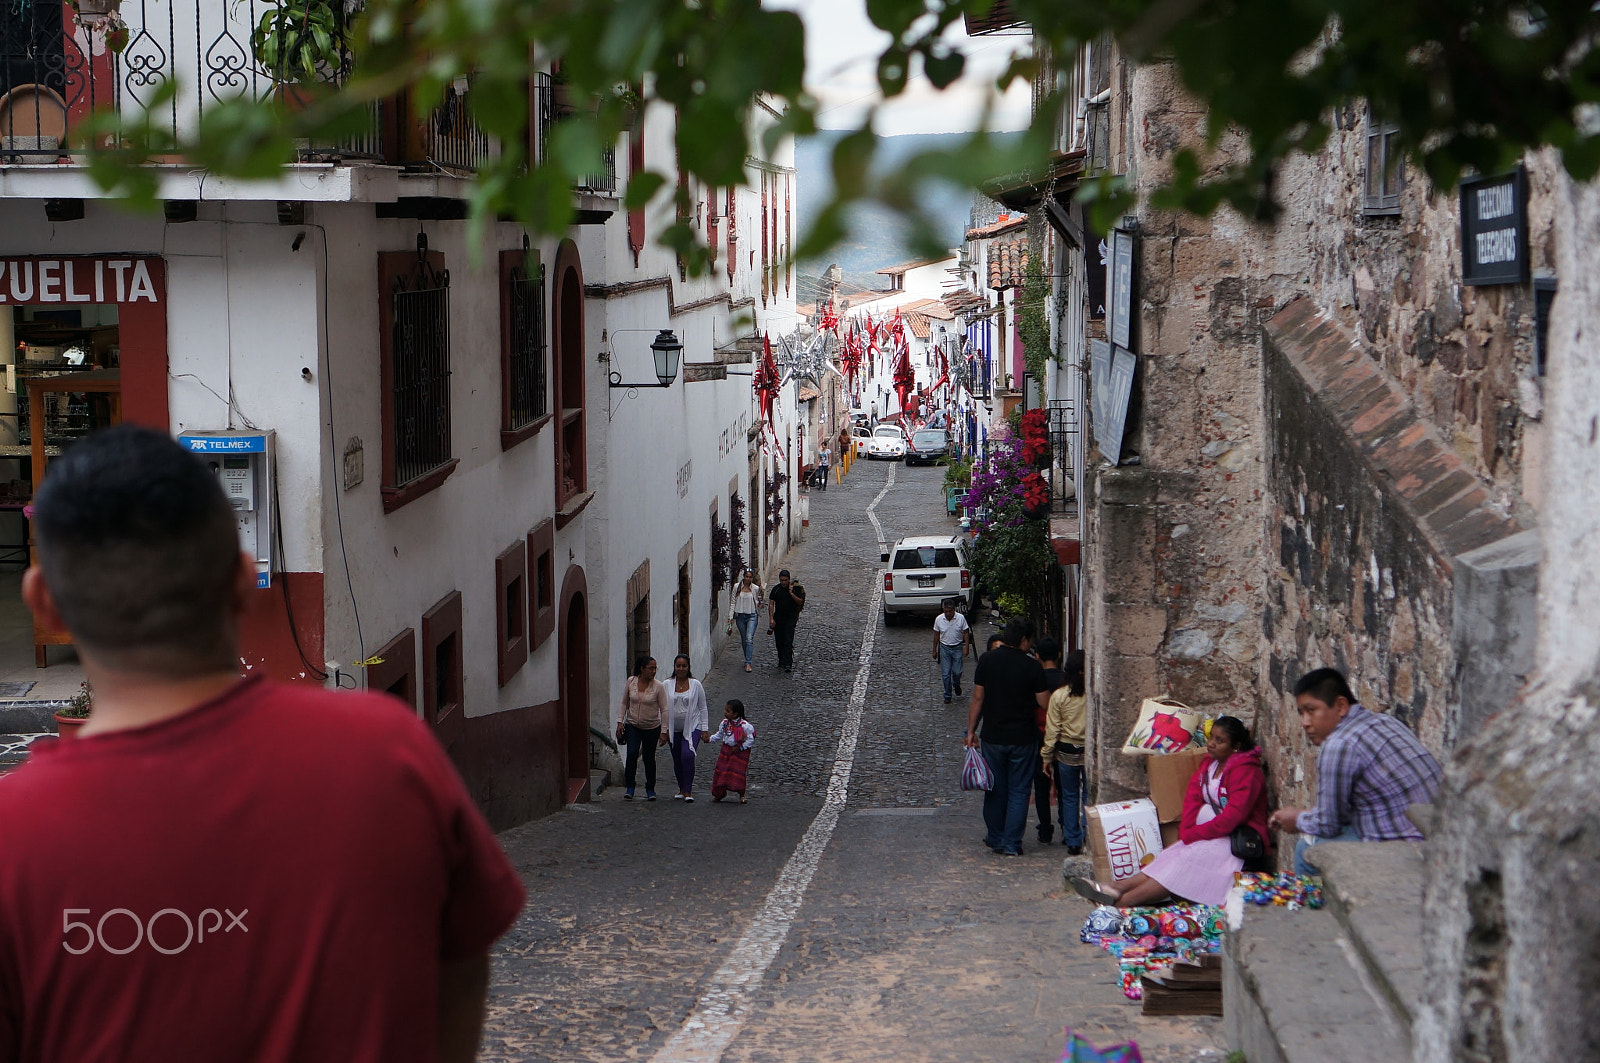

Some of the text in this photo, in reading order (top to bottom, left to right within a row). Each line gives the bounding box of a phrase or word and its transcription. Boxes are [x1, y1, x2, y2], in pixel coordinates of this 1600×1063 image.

[1477, 183, 1514, 220] TELECOMM
[1475, 227, 1517, 265] TELEGRAFOS
[209, 440, 252, 449] TELMEX
[1107, 824, 1135, 882] WIEB
